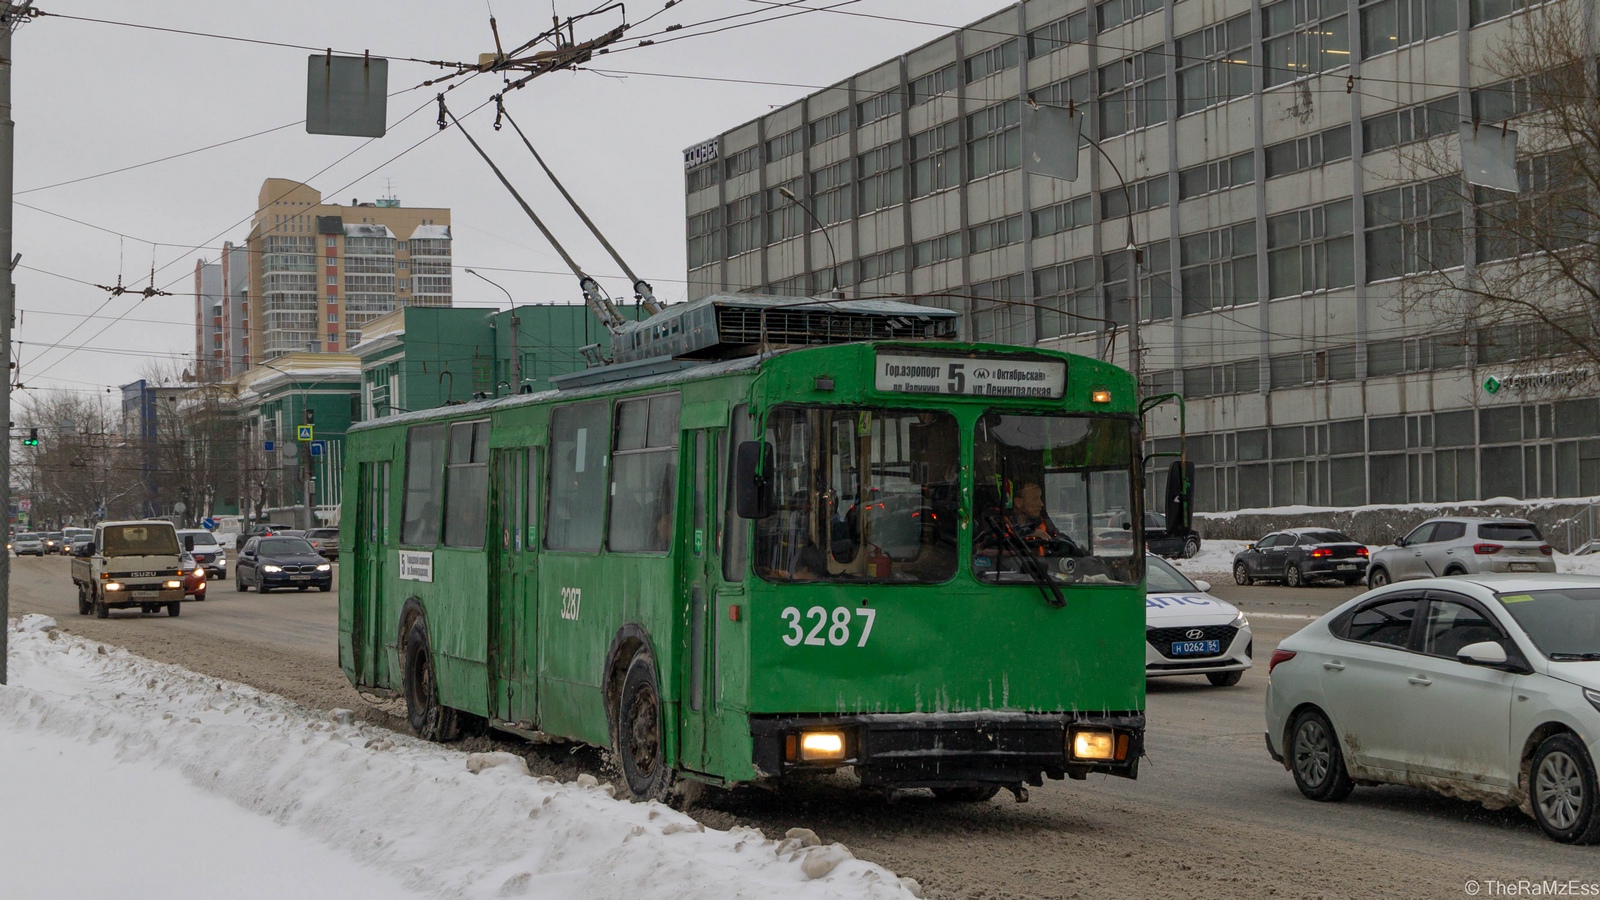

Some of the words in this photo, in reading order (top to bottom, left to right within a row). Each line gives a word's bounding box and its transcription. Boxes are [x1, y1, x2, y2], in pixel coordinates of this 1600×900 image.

[885, 363, 941, 379] Гор.аэропорт
[947, 363, 965, 394] 5
[561, 587, 581, 621] 3287
[780, 606, 877, 648] 3287
[1183, 642, 1205, 653] 0262
[1208, 641, 1217, 649] 54
